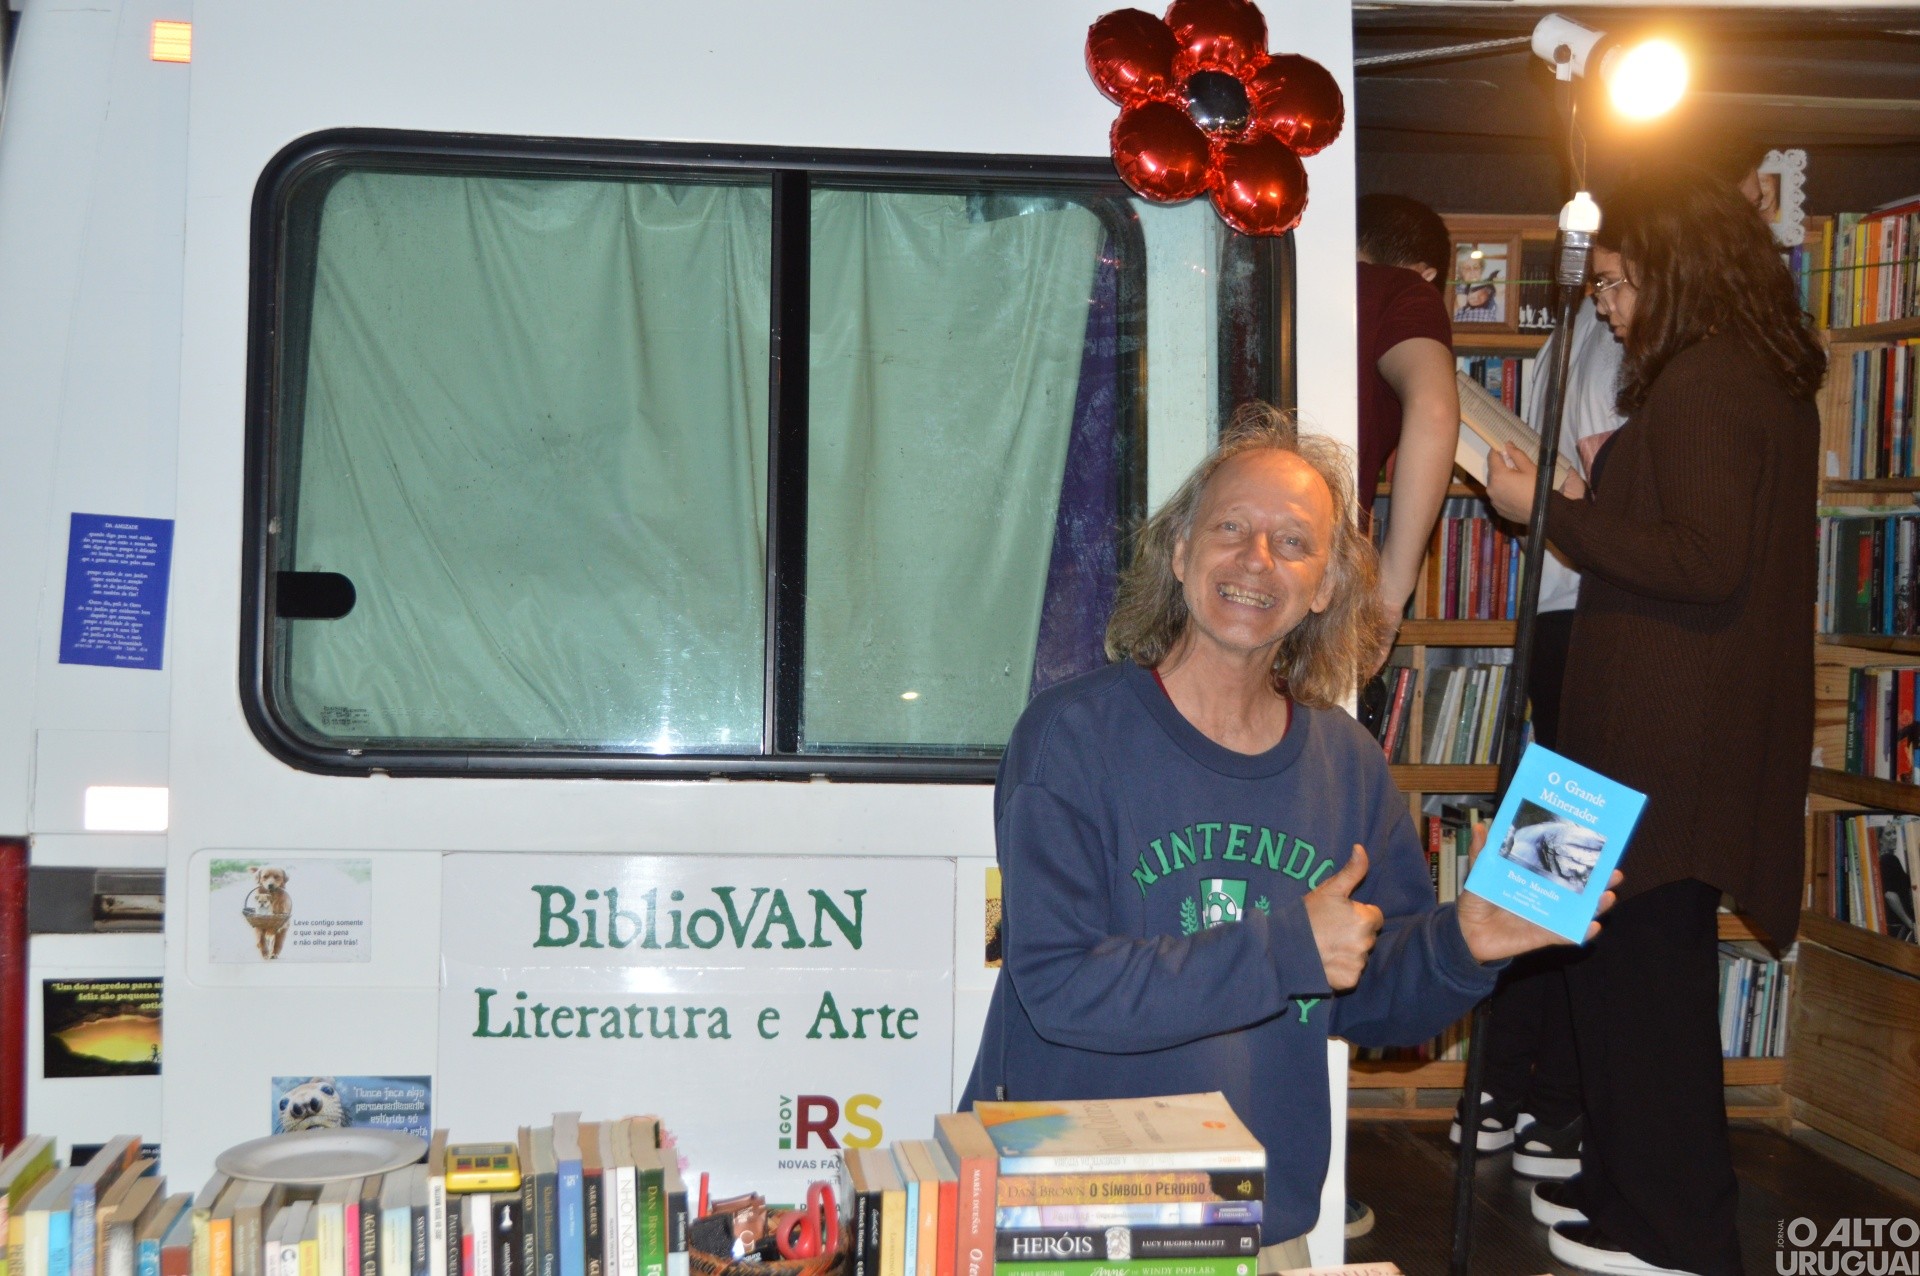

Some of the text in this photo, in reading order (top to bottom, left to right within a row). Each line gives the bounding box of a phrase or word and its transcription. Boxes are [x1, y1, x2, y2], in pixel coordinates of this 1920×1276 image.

[1548, 772, 1606, 807] O Grande
[1539, 788, 1598, 824] Minerador
[1507, 870, 1526, 885] Pedro
[311, 919, 335, 927] contigo
[531, 884, 867, 950] BiblioVAN
[91, 982, 130, 991] segredos
[117, 993, 159, 1001] pequenos
[473, 987, 920, 1040] Literatura e Arte
[780, 1095, 792, 1134] GOV
[796, 1093, 883, 1149] RS
[778, 1160, 817, 1169] NOVAS
[589, 1185, 597, 1205] SARA
[973, 1169, 981, 1197] MARÍA
[1008, 1181, 1205, 1198] DAN BROWN O SÍMBOLO PERDIDO
[647, 1186, 658, 1210] DAN
[858, 1196, 866, 1228] Sherlock
[449, 1214, 458, 1244] PAULO
[620, 1179, 635, 1269] ELTON JOHN
[972, 1200, 981, 1234] DUEÑAS
[364, 1212, 375, 1257] AGATHA
[647, 1215, 658, 1256] BROWN
[857, 1229, 865, 1256] Holmes
[1012, 1232, 1093, 1255] HERÓIS
[970, 1248, 983, 1260] O
[1142, 1267, 1171, 1275] WINDY
